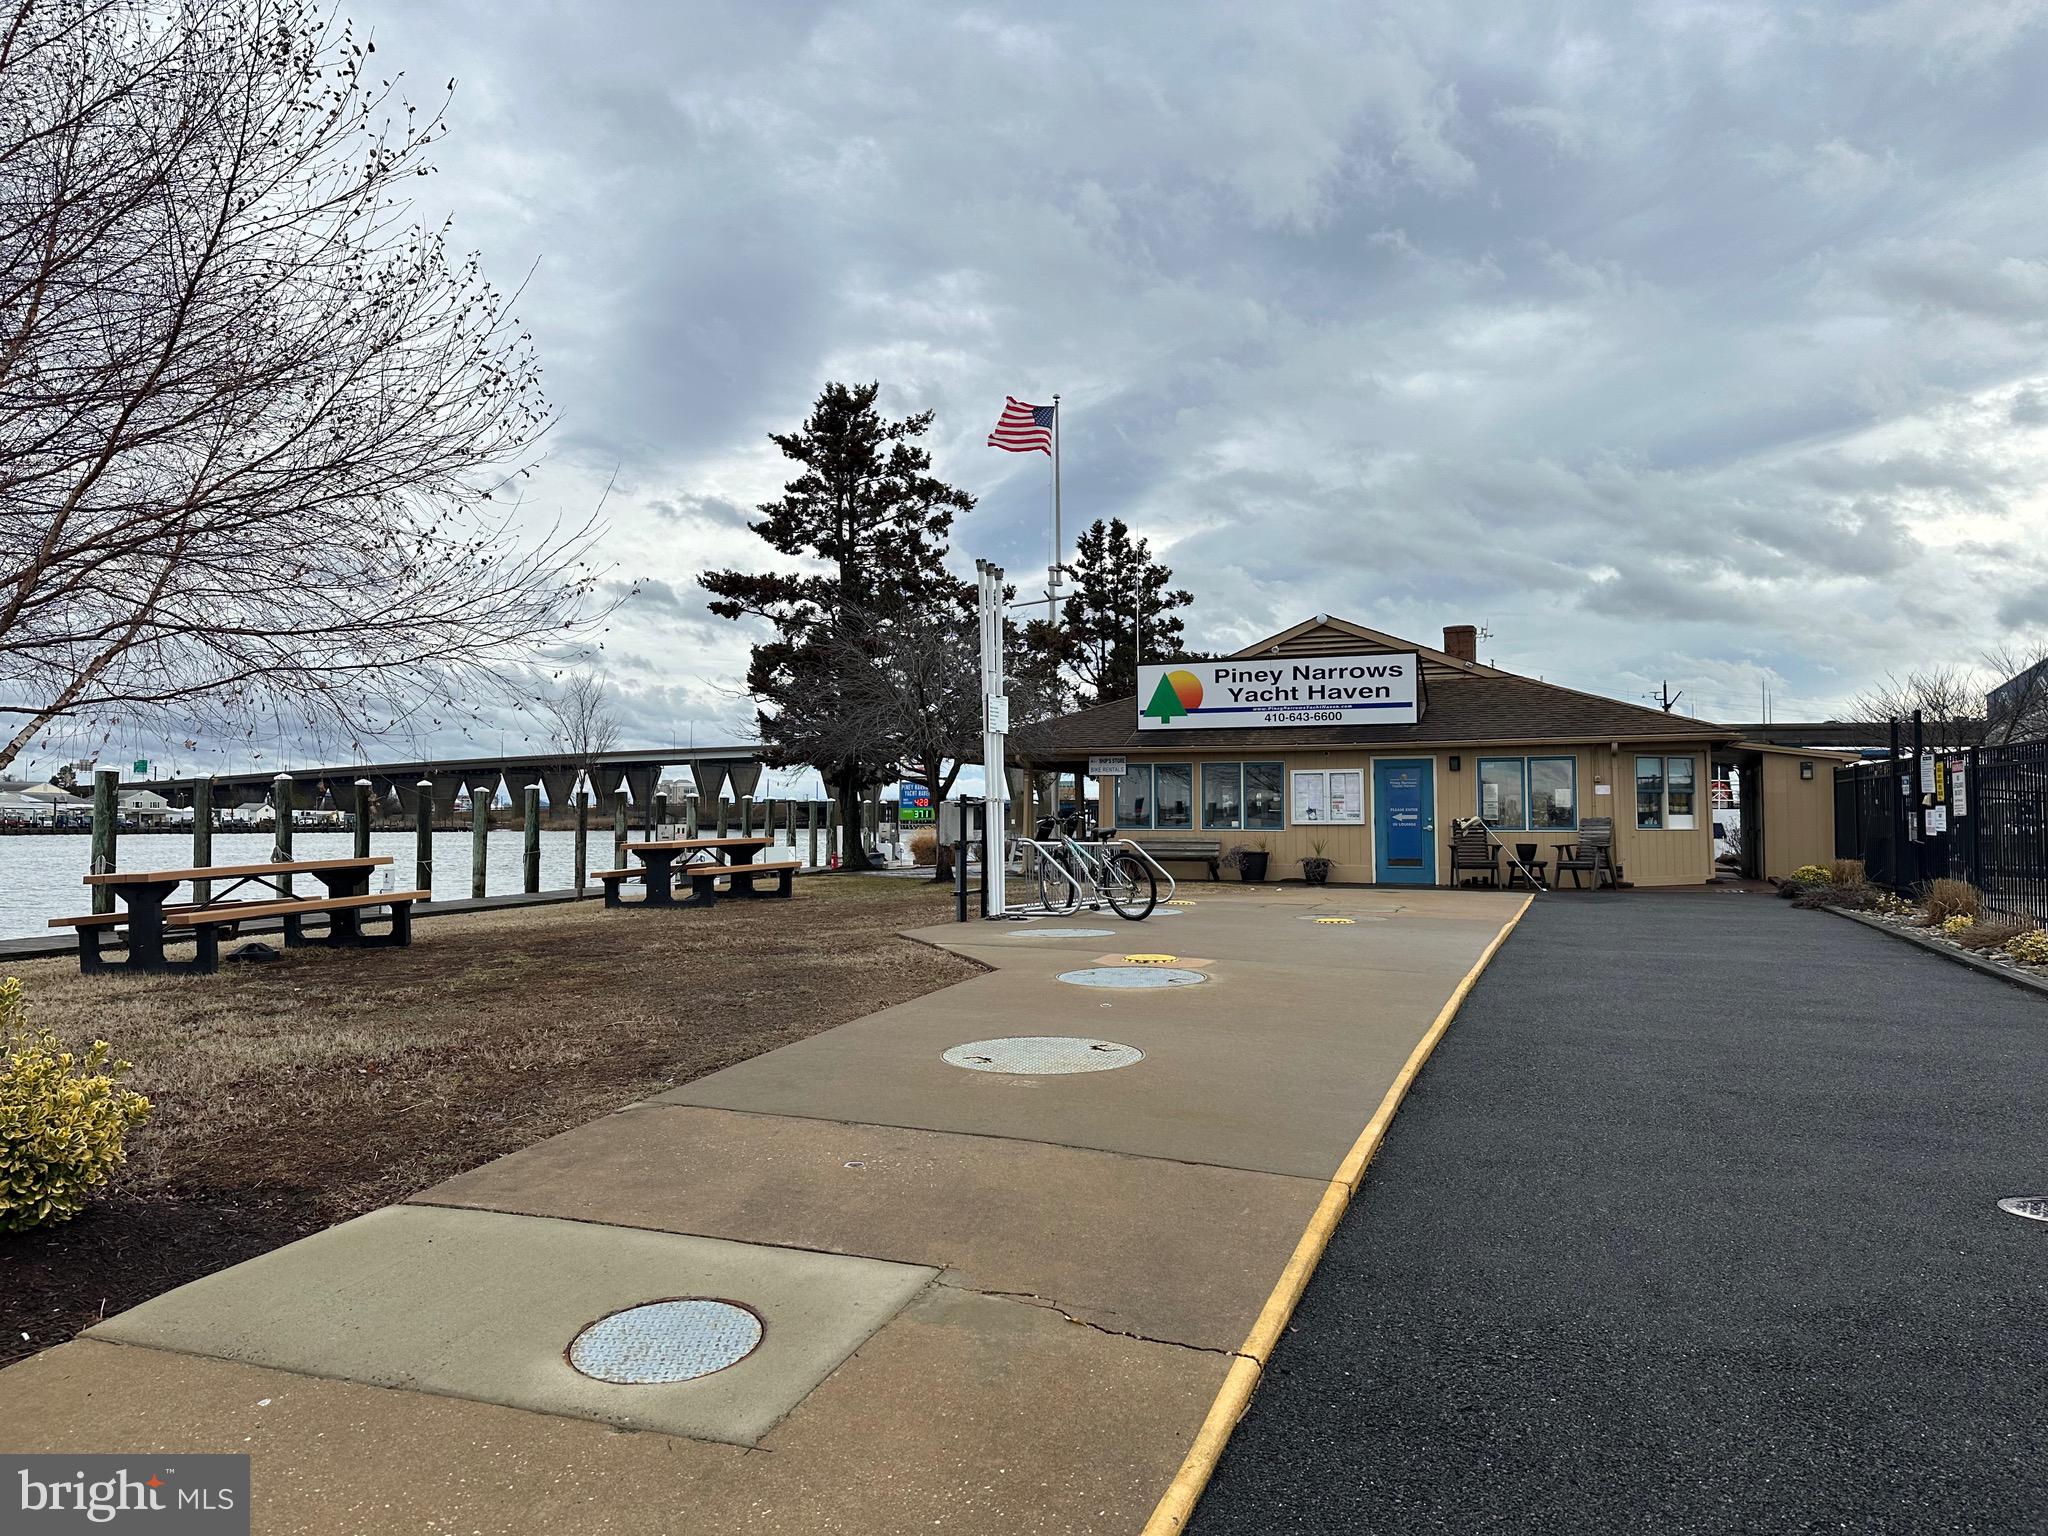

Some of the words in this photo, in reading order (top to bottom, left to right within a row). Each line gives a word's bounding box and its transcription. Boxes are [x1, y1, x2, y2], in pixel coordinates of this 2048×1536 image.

[1214, 668, 1283, 685] Piney
[1292, 664, 1404, 681] Narrows
[1228, 686, 1299, 703] Yacht
[1308, 684, 1390, 700] Haven
[1264, 711, 1343, 723] 410-643-6600
